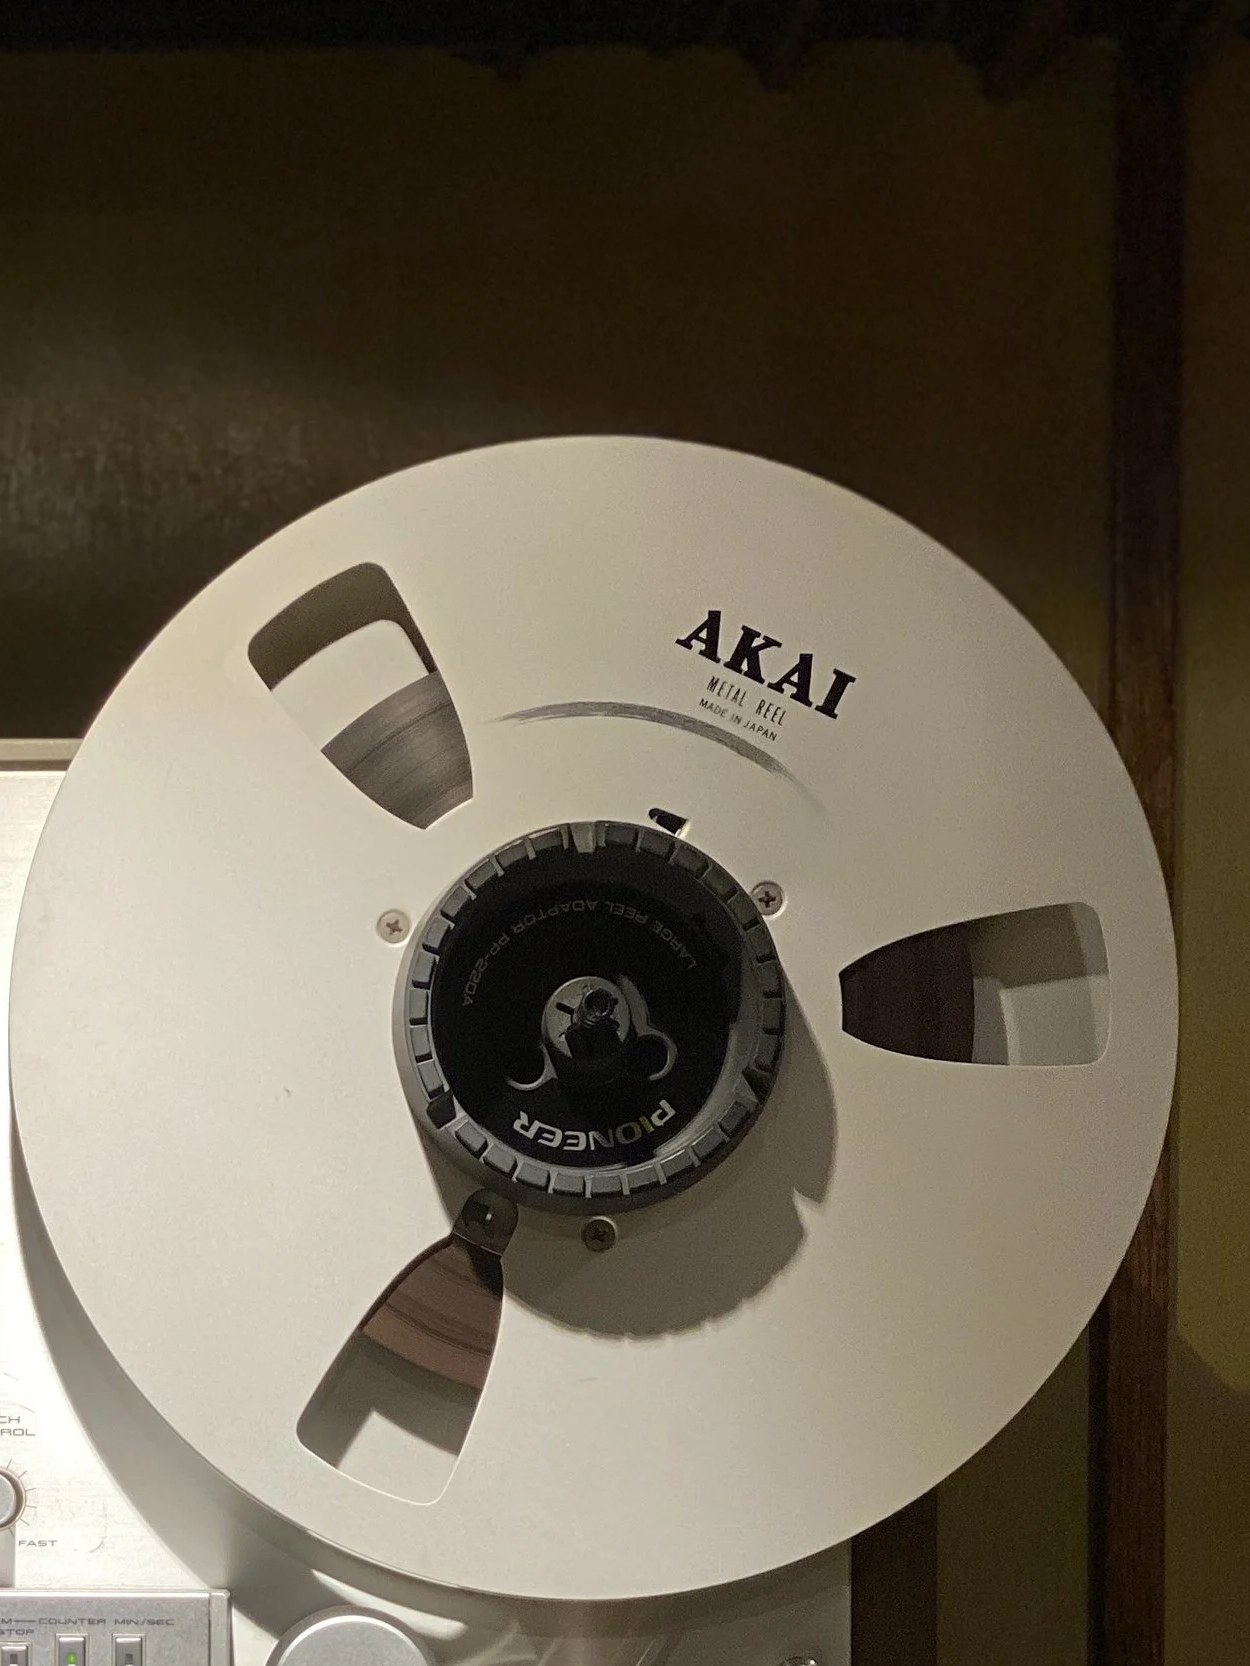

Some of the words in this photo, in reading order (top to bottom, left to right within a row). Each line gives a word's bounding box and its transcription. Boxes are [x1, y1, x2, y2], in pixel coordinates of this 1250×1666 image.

[675, 609, 857, 720] AKAI
[698, 697, 728, 719] MADE
[730, 712, 742, 726] IN
[742, 718, 778, 742] JAPAN
[706, 675, 748, 707] METAL
[755, 699, 788, 726] REEL
[511, 899, 598, 935] ADAPTOR
[605, 901, 649, 925] REEL
[653, 919, 698, 969] LARGE
[461, 932, 511, 1008] PP-220A
[512, 1099, 677, 1152] PIONEER
[38, 1617, 106, 1626] COUNTER
